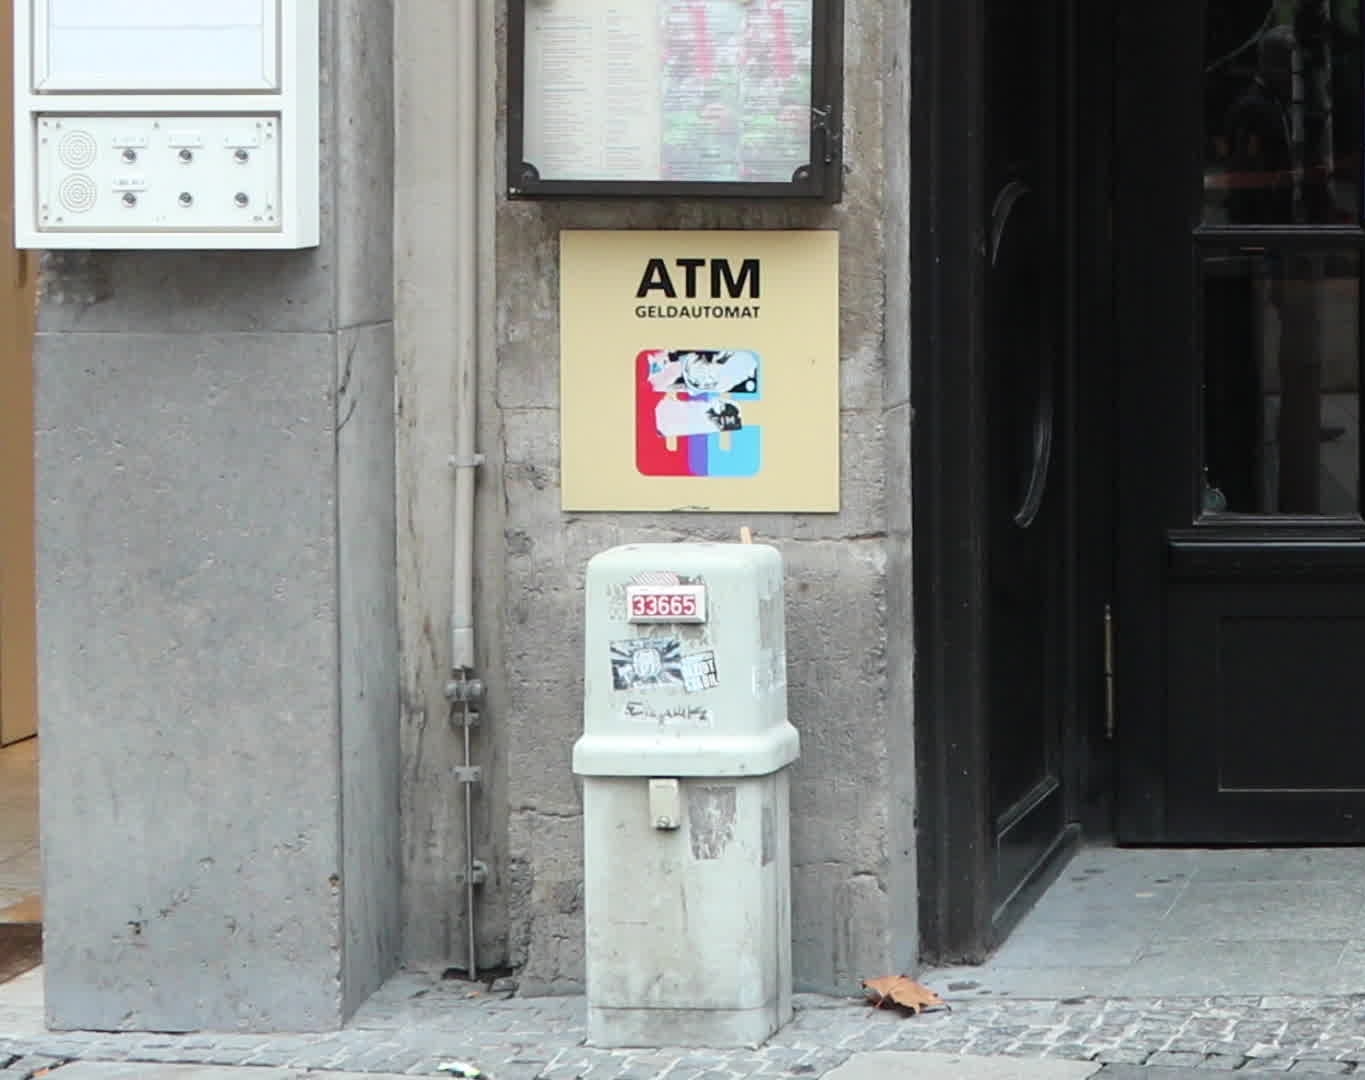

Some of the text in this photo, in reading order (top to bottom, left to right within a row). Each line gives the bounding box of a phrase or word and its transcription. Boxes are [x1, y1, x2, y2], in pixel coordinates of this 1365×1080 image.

[635, 258, 760, 299] ATM
[635, 305, 760, 319] GELDAUTOMAT
[631, 593, 696, 617] 33665
